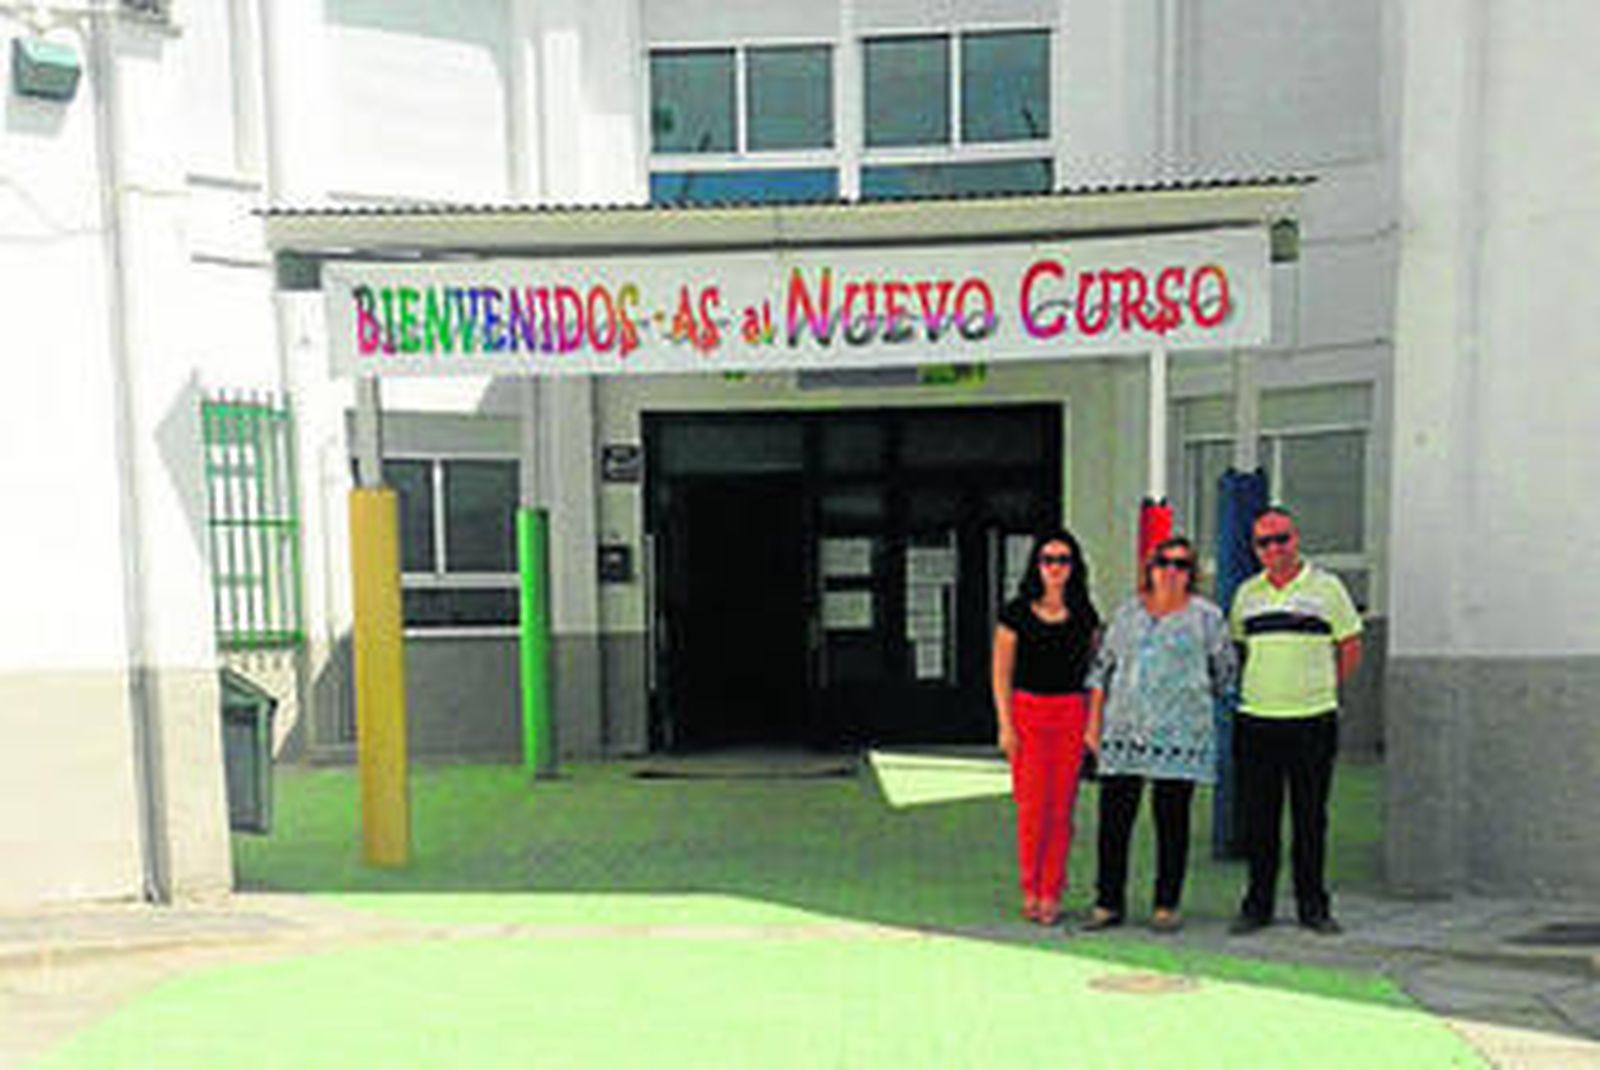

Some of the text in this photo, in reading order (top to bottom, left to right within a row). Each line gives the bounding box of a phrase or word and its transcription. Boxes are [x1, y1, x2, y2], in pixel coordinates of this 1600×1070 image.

[354, 284, 639, 358] BIENVENIDOS
[786, 266, 996, 347] NUEVO
[1020, 258, 1232, 339] CURSO
